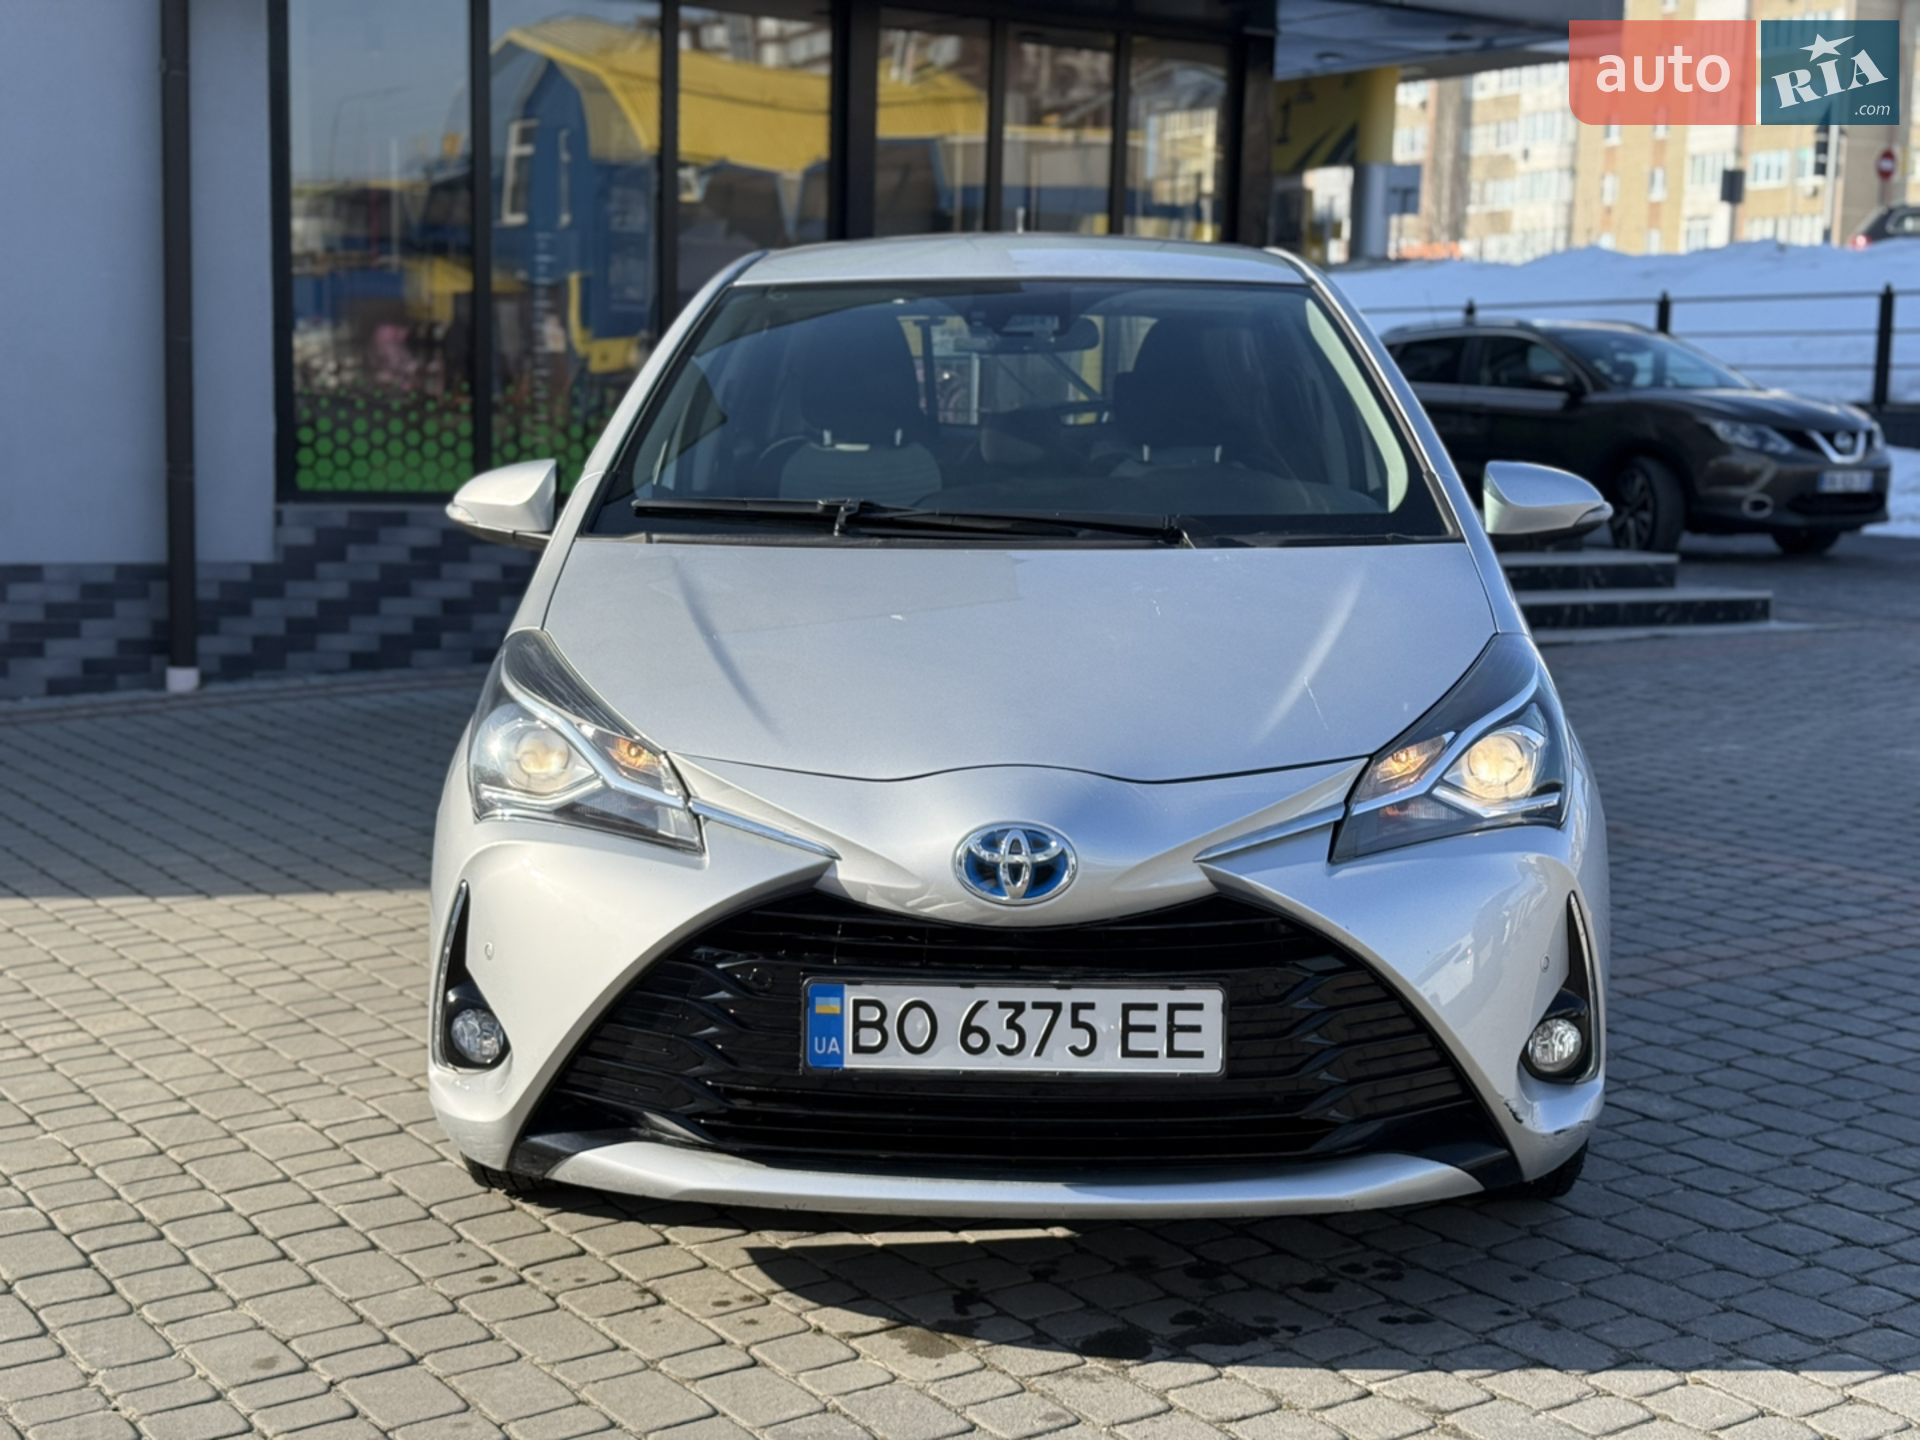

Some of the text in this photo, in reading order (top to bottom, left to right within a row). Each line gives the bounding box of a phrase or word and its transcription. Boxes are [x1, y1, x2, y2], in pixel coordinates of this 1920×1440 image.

[814, 1037, 841, 1055] UA
[852, 998, 1205, 1059] BO 6375 EE
